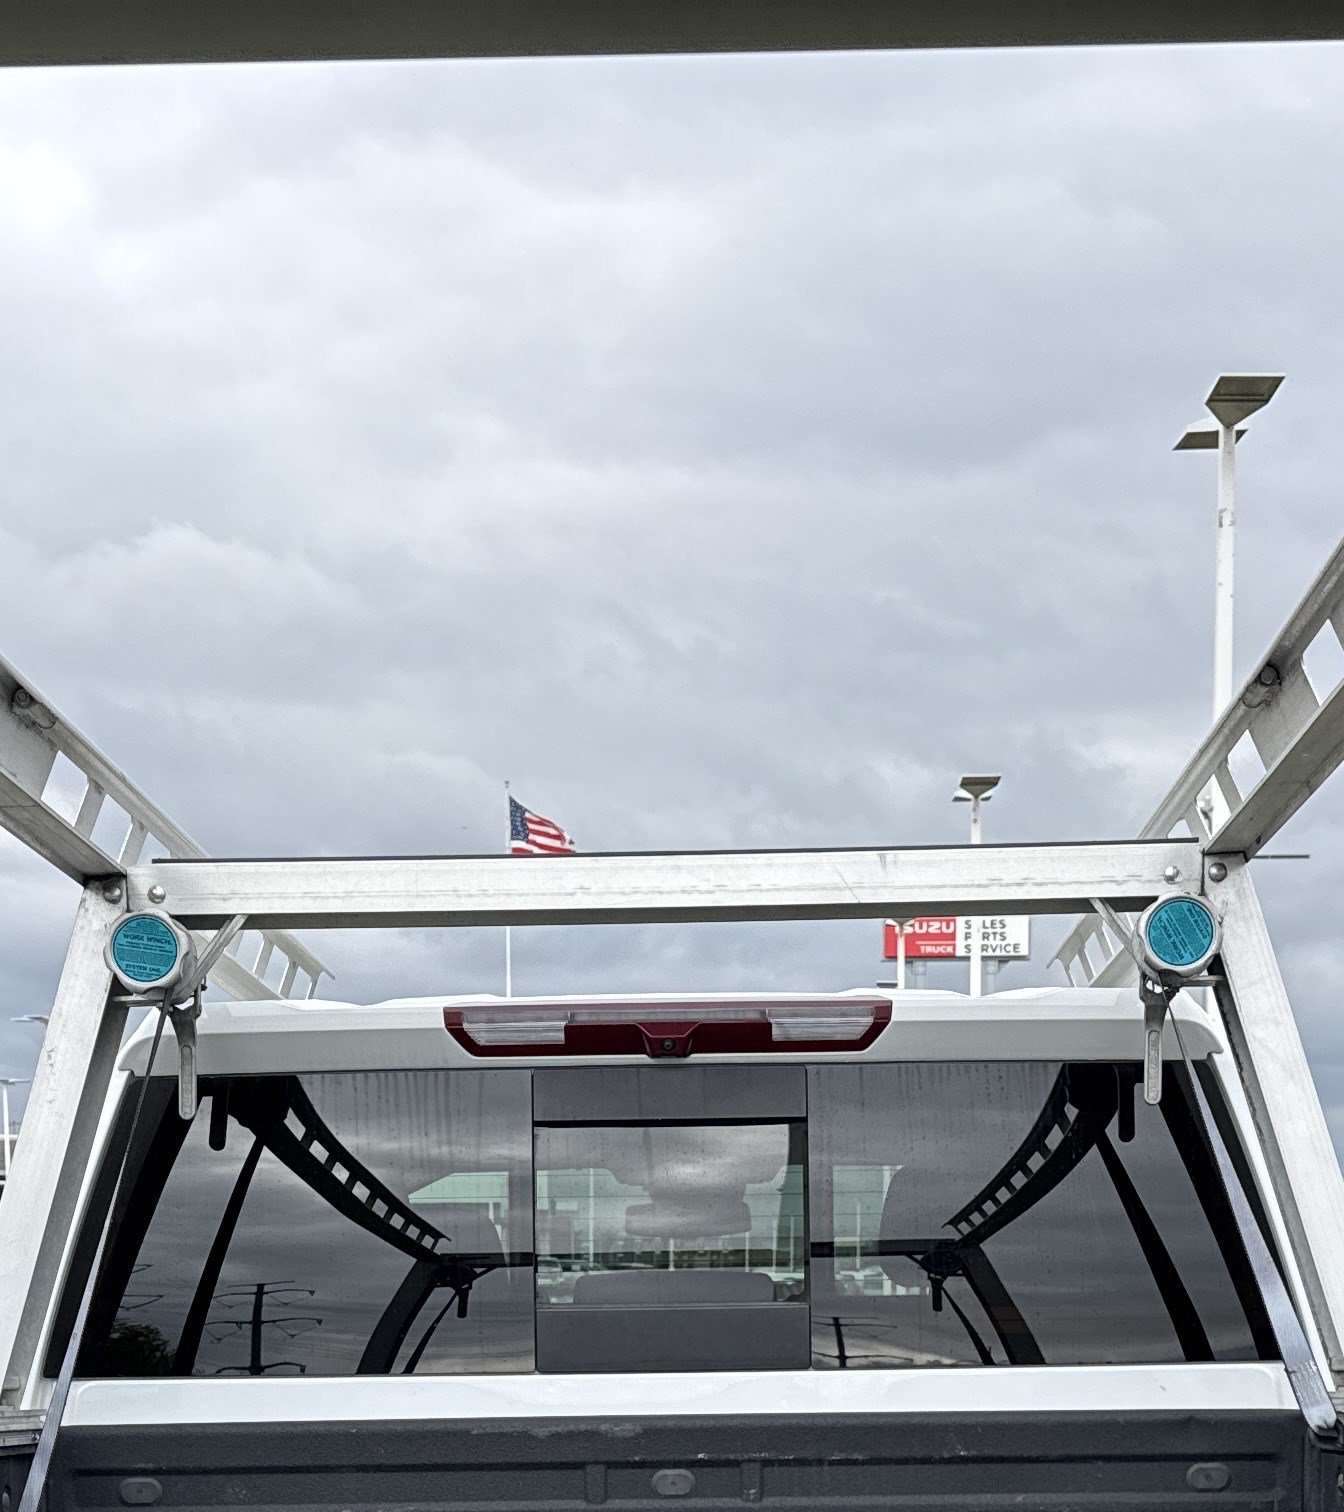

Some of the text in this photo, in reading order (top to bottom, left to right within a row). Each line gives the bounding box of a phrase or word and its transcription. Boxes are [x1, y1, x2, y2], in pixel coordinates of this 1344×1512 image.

[964, 919, 1006, 930] SLES
[964, 931, 1007, 942] PRTS
[919, 945, 954, 954] TRUCK
[964, 943, 1021, 954] SRVICE
